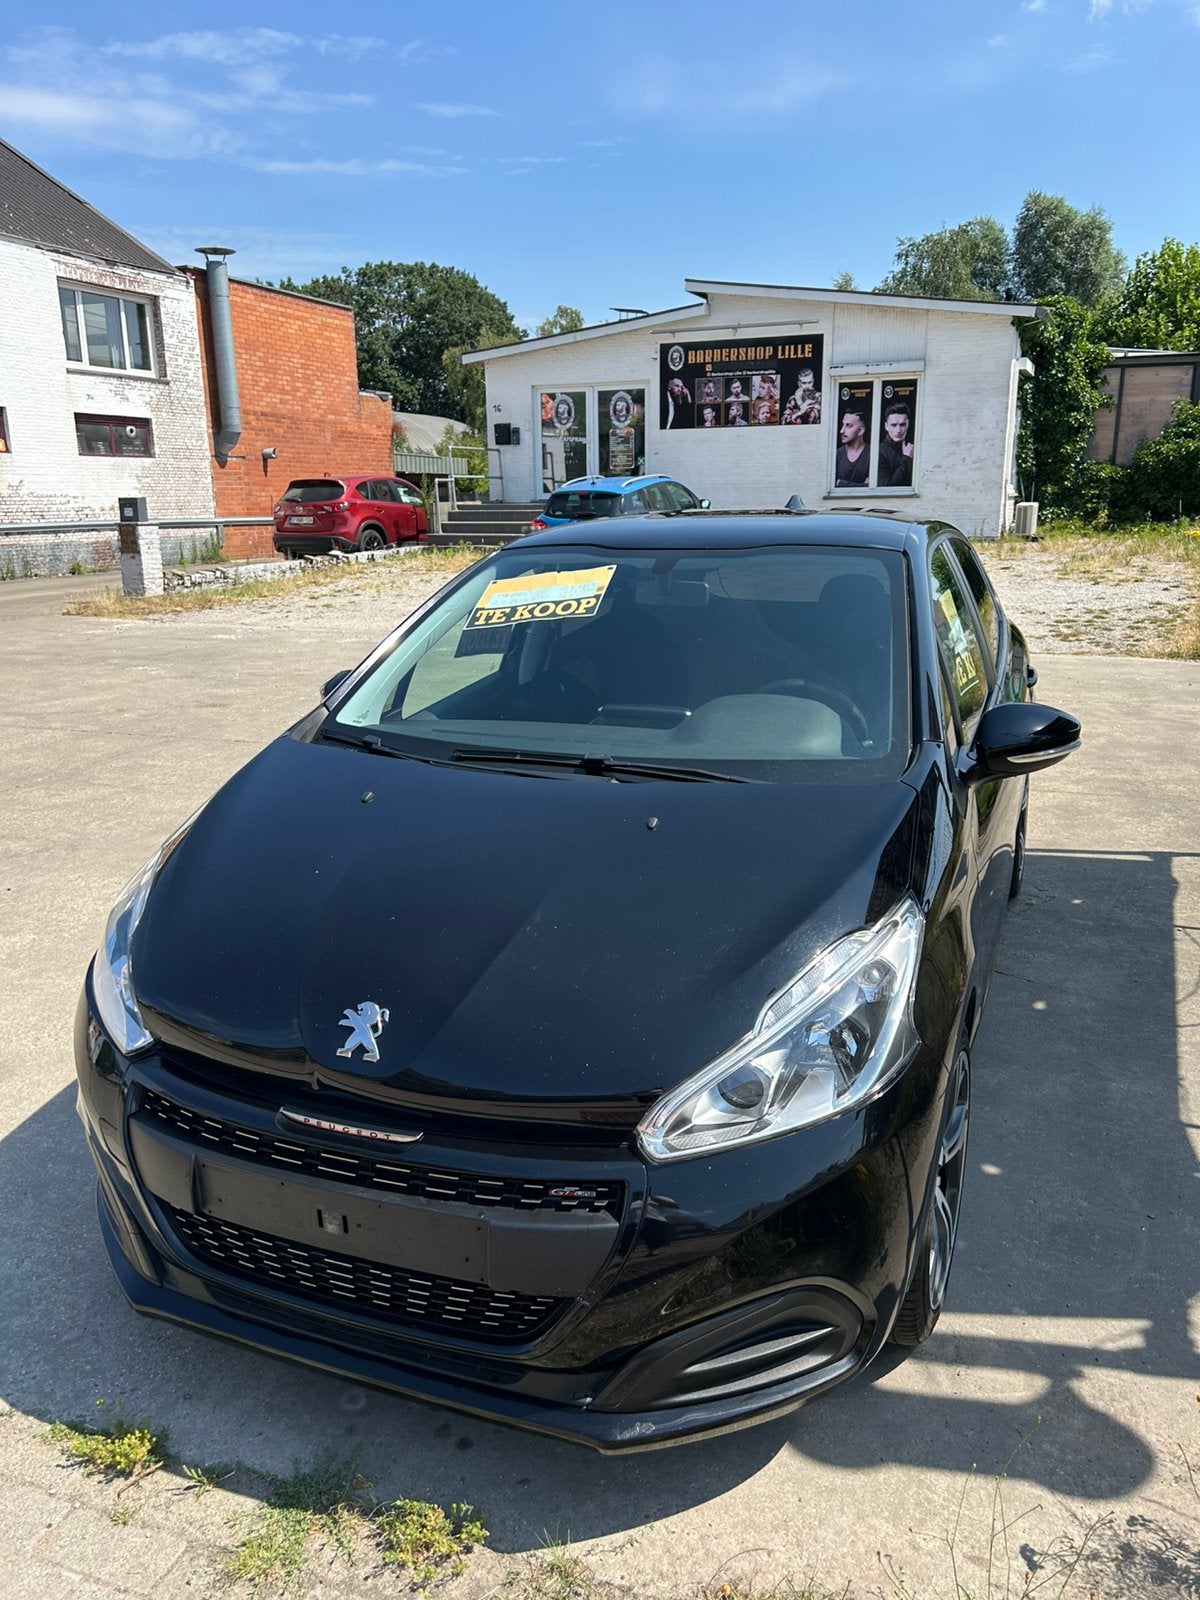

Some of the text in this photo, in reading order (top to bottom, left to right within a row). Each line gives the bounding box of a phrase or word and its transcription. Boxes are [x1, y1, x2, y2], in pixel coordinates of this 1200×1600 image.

[688, 343, 813, 364] BARBERSHOP LILLE
[492, 404, 502, 413] 16
[474, 597, 597, 625] TE KOOP
[303, 1117, 392, 1140] PEUGEOT
